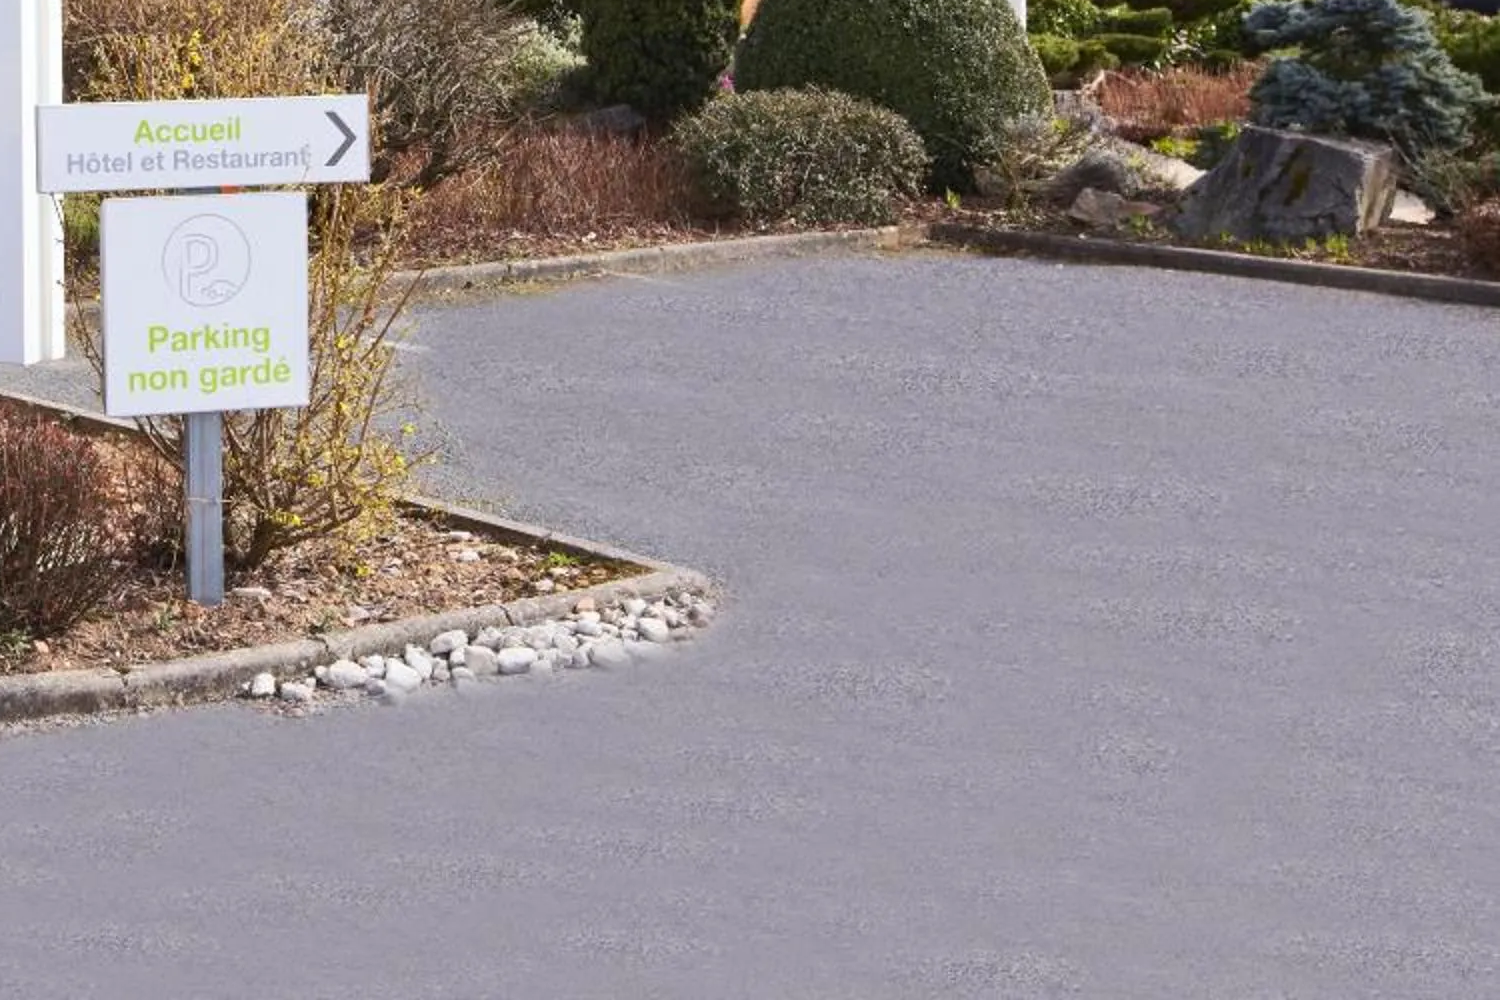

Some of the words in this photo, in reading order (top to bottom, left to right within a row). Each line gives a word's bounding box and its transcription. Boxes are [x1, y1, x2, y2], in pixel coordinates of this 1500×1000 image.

[133, 116, 242, 144] Accueil
[67, 151, 133, 175] Hôtel
[140, 151, 165, 172] et
[173, 145, 309, 172] Restaurant
[148, 322, 271, 354] Parking
[128, 367, 189, 392] non
[199, 356, 292, 394] gardé
